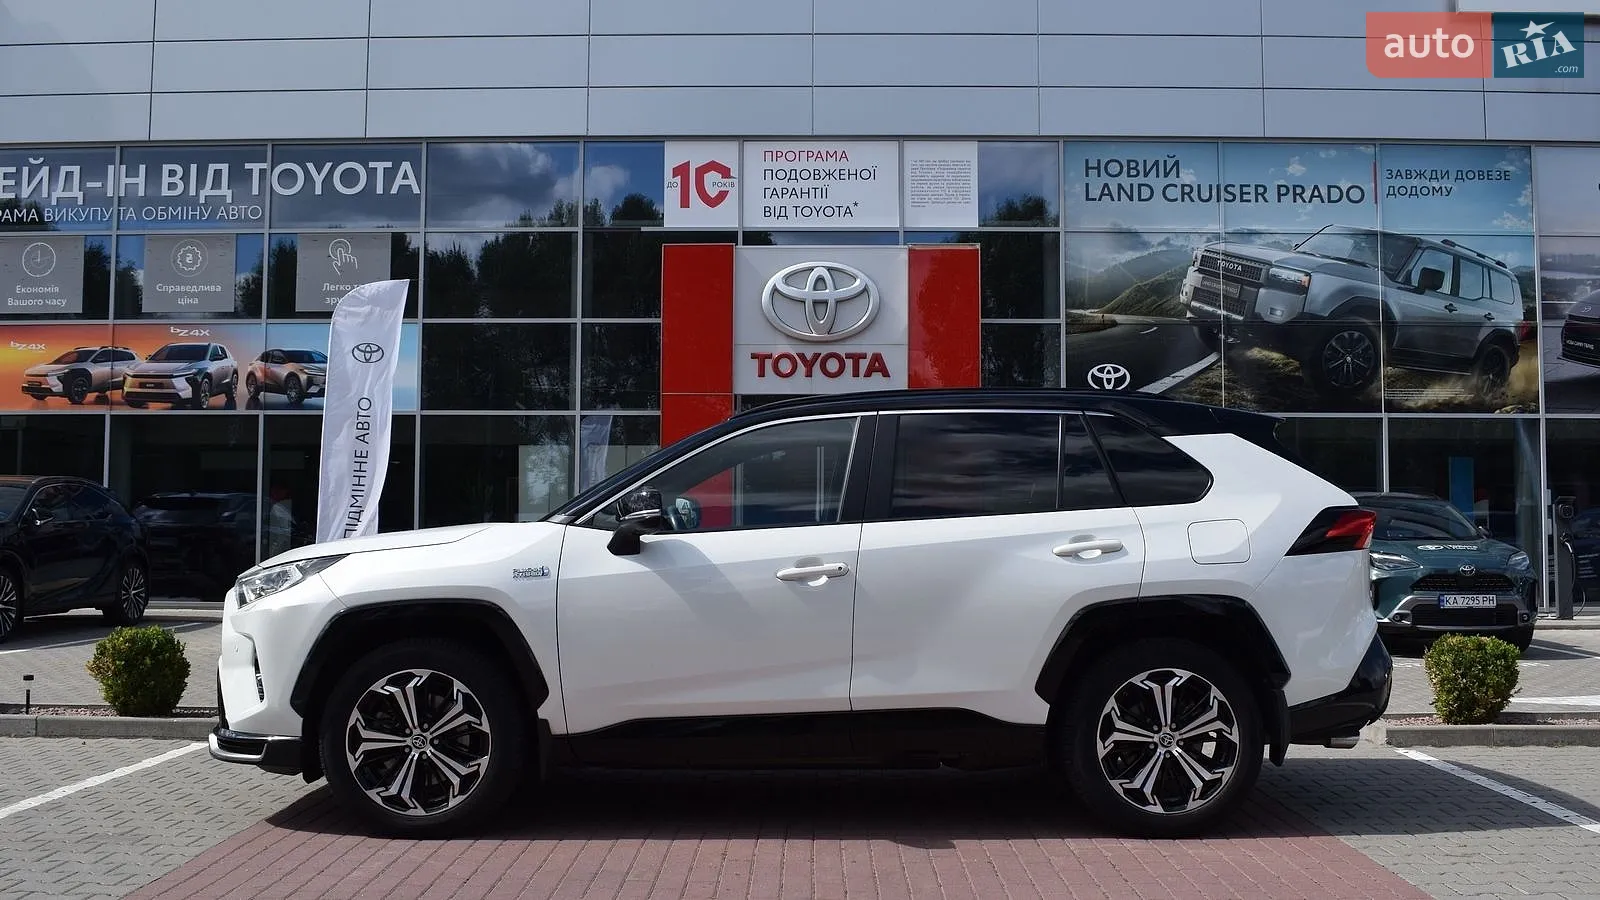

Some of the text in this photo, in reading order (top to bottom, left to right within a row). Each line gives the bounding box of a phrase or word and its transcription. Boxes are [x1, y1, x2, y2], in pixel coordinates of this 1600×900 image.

[763, 150, 849, 162] ПРОГРАМА
[1084, 153, 1180, 178] НОВИЙ
[763, 165, 878, 183] ПОДОВЖЕНОЇ
[1386, 169, 1511, 182] ЗАВЖДИ ДОВЕЗЕ
[161, 163, 233, 204] ВІД
[244, 161, 421, 196] TOYOTA
[666, 181, 679, 189] ДО
[763, 184, 830, 199] ГАРАНТІЇ
[1084, 182, 1365, 204] LAND CRUISER PRADO
[1386, 185, 1453, 199] ДОДОМУ
[0, 205, 262, 222] АМА ВИКУПУ ТА ОБМІНУ АВТО
[763, 205, 788, 220] ВІД
[1217, 260, 1242, 272] TOYOTA
[16, 284, 60, 294] Економія
[156, 283, 222, 293] Справедлива
[322, 282, 351, 292] Легко
[7, 297, 67, 307] Вашого часу
[177, 295, 199, 306] ціна
[750, 351, 891, 379] TOYOTA
[344, 397, 372, 539] ПІДМІННЕ АВТО
[1460, 596, 1480, 605] 7295
